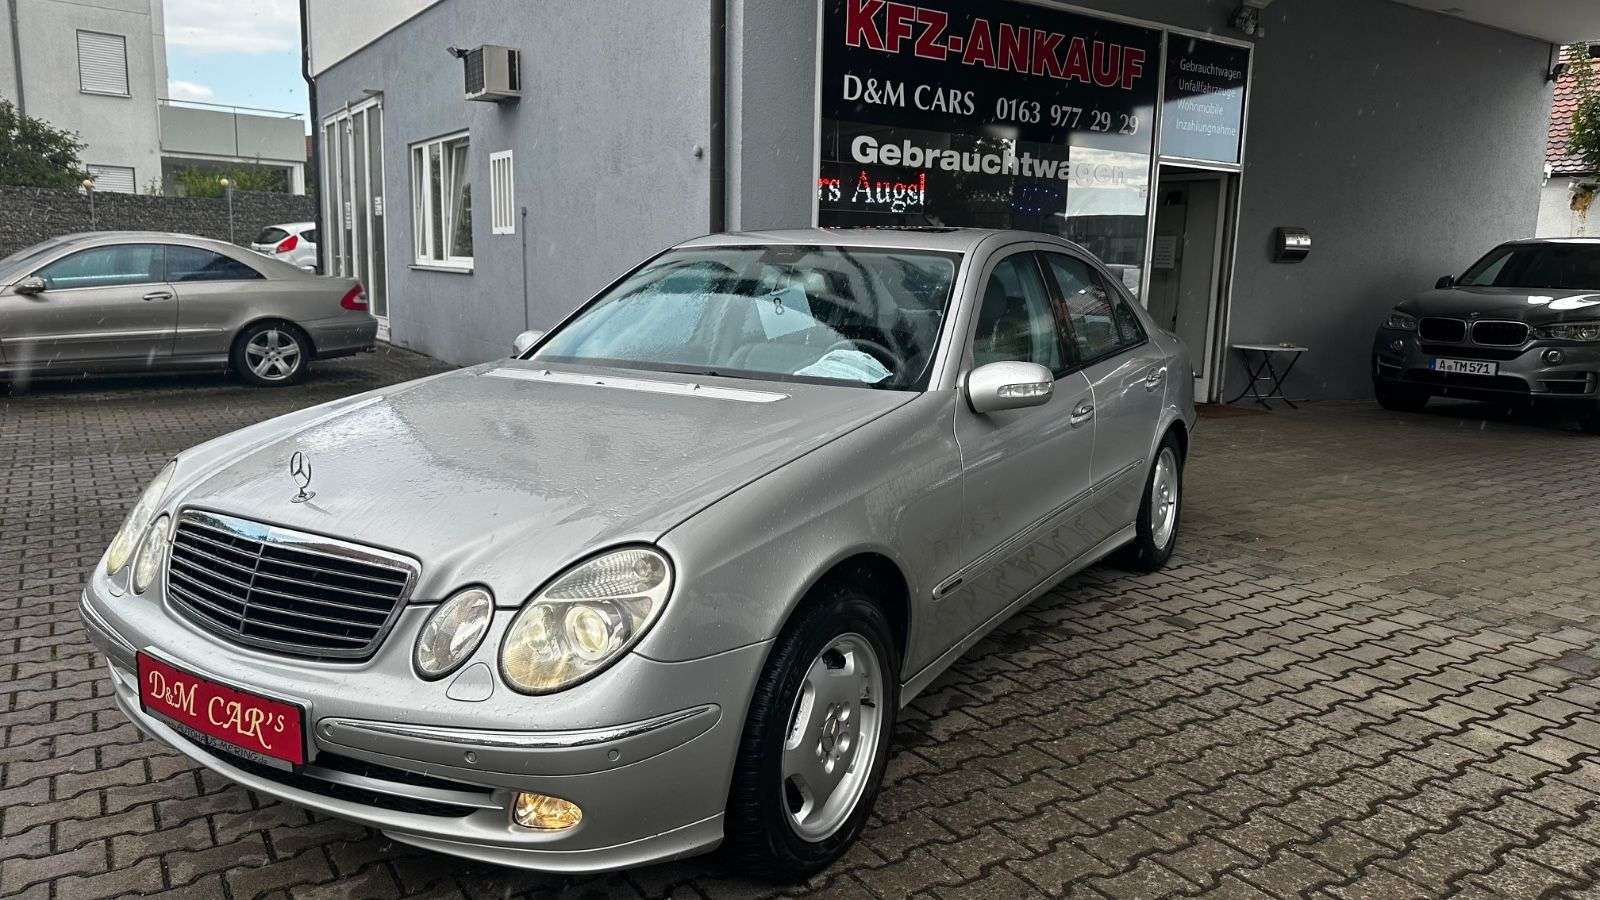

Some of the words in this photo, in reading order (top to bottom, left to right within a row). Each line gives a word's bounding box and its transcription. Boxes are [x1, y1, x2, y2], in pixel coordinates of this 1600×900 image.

[845, 0, 1146, 90] KFZ-ANKAUF
[1179, 58, 1242, 81] Gebrauchtwagen
[843, 74, 906, 108] D&M
[914, 84, 977, 117] CARS
[996, 97, 1041, 124] 0163
[1050, 104, 1083, 128] 977
[1090, 109, 1111, 132] 29
[1118, 113, 1139, 136] 29
[1175, 119, 1237, 137] Inzahlungnahme
[1177, 99, 1224, 115] Wohnmobile
[852, 135, 1127, 187] Gebrauchtwagen
[149, 670, 199, 717] D&M
